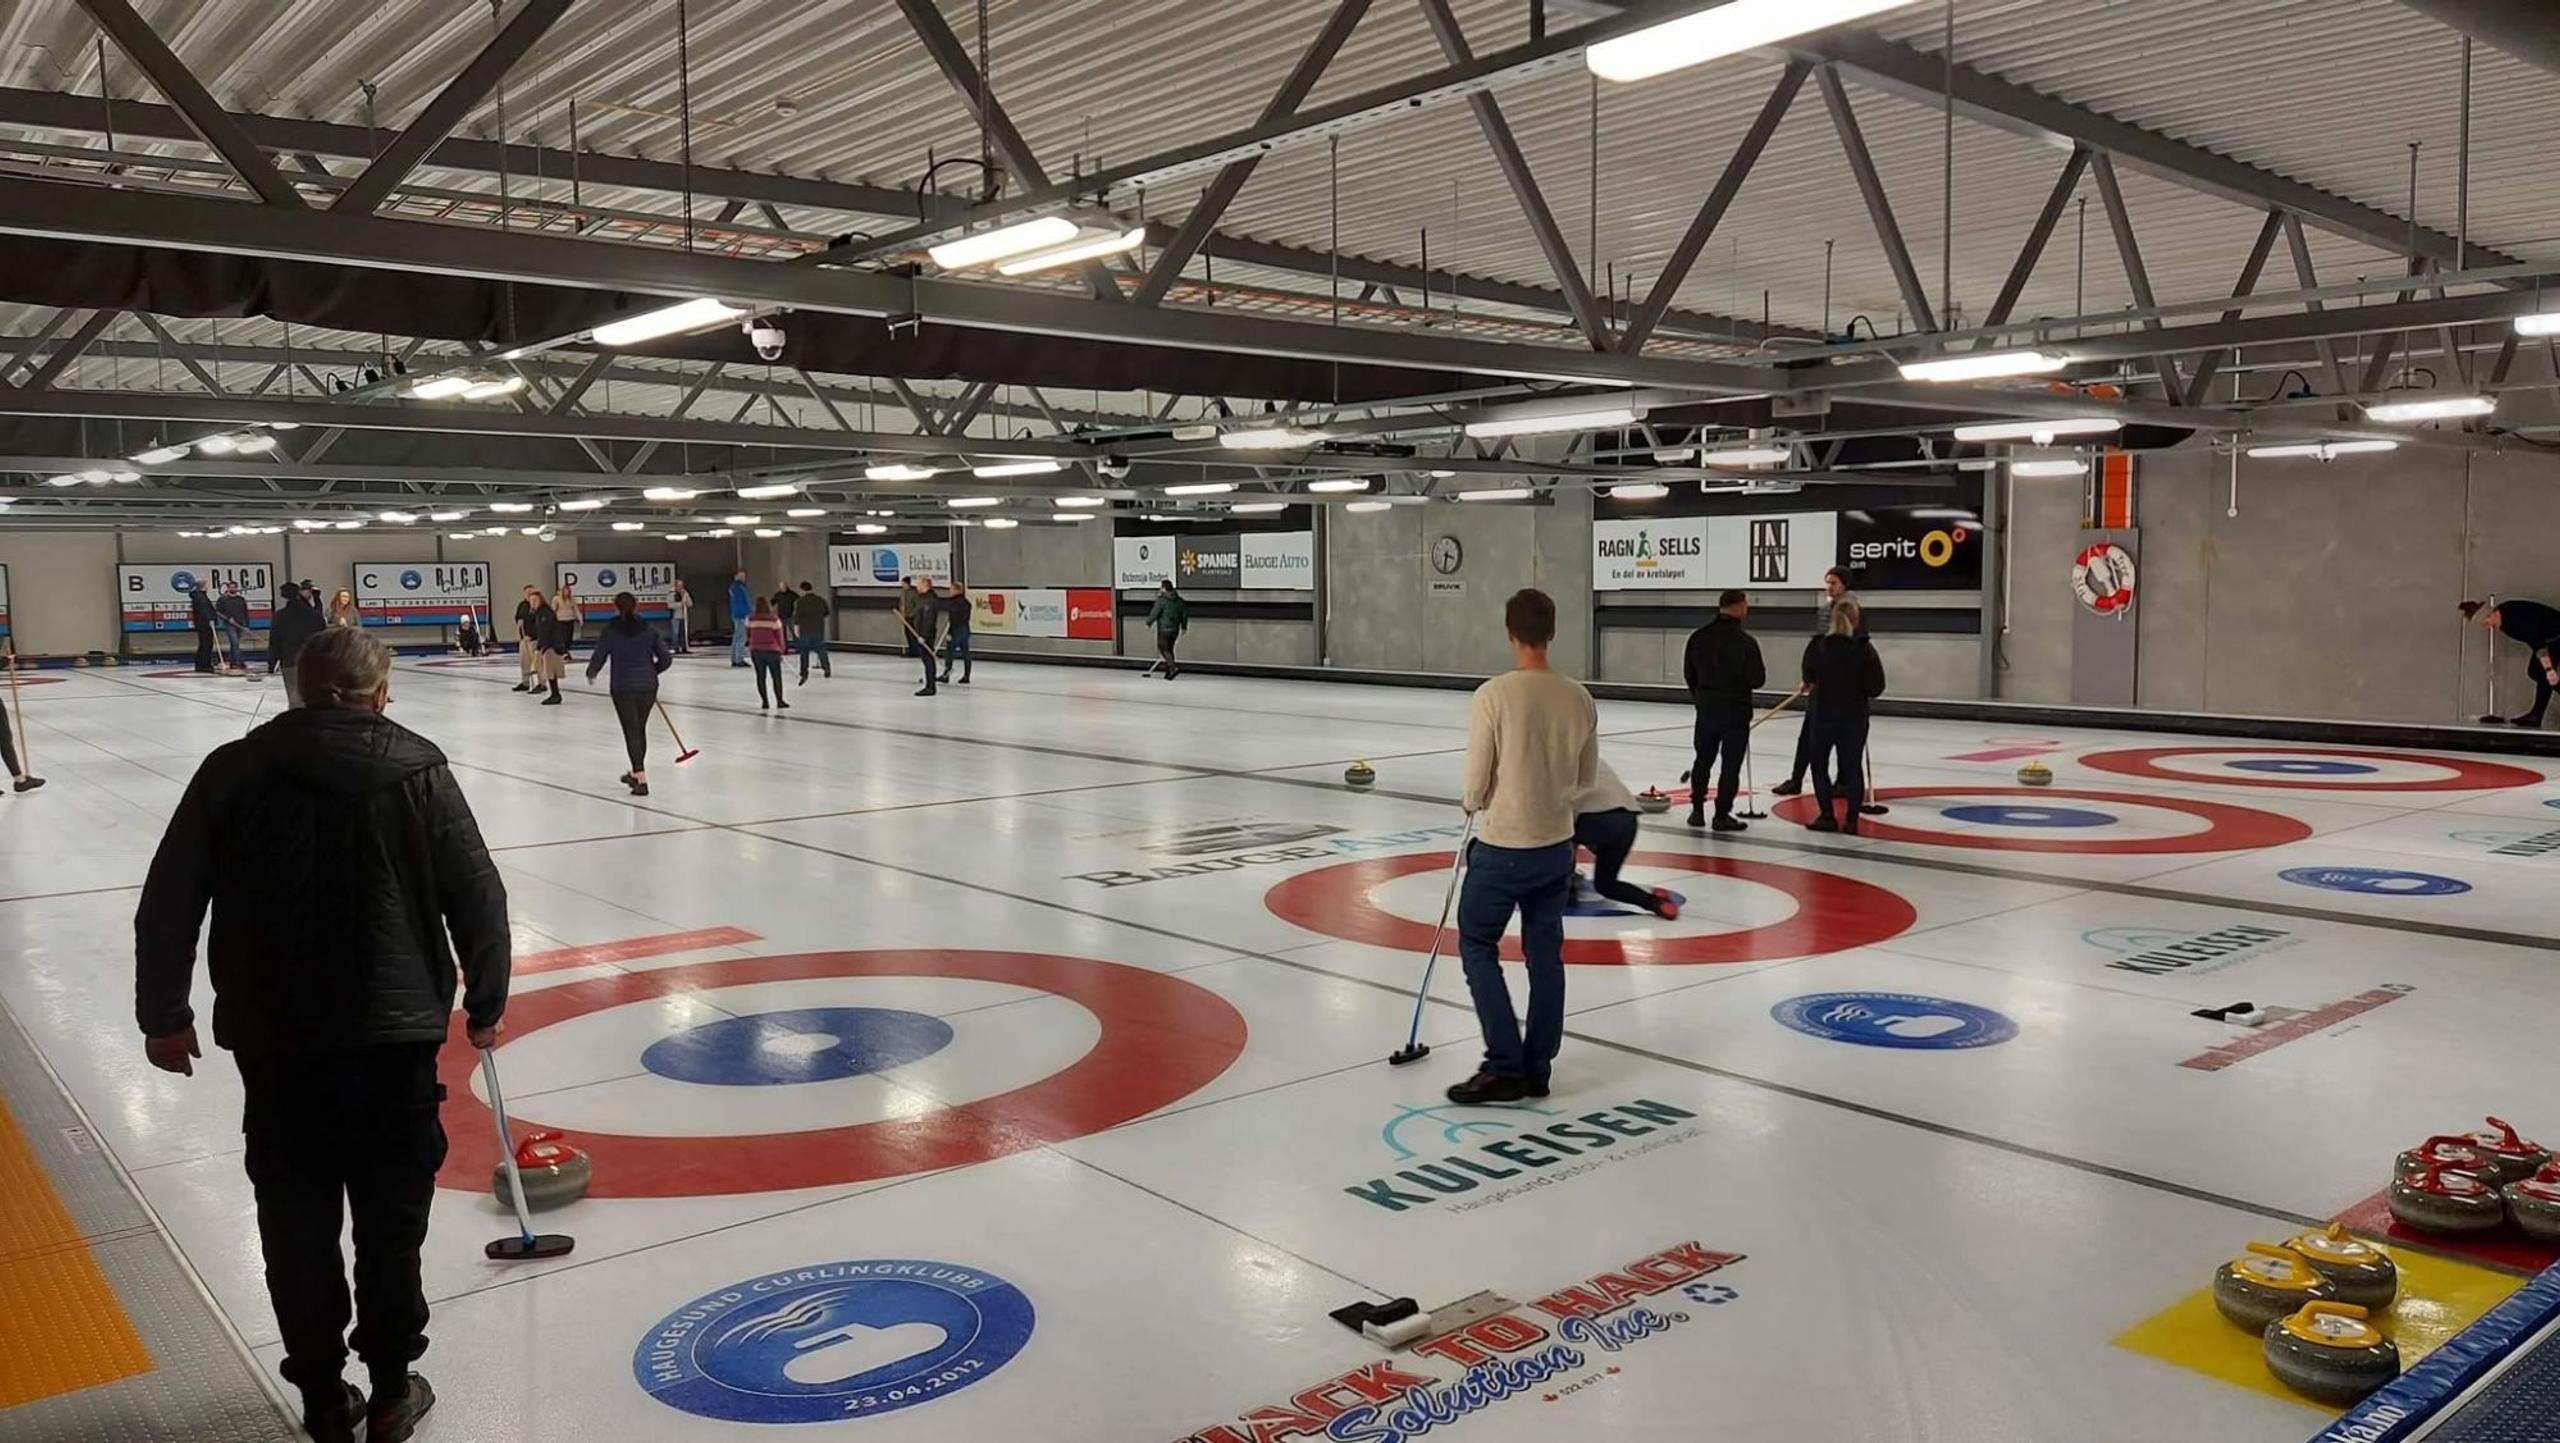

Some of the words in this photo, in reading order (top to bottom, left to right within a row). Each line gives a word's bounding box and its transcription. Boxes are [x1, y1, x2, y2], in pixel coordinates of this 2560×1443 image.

[1599, 540, 1634, 558] RAGN
[1659, 537, 1701, 556] SELLS
[1849, 537, 1916, 559] serit
[838, 552, 860, 572] MM
[1197, 552, 1238, 569] SPANNE
[1245, 554, 1278, 569] BAUGE
[1279, 553, 1310, 569] AUTO
[128, 575, 145, 592] B
[211, 569, 266, 589] RICO
[362, 573, 378, 589] C
[435, 567, 483, 586] RICO
[564, 572, 578, 586] D
[628, 566, 671, 585] RICO
[1060, 847, 1338, 889] BAUGE
[1329, 825, 1478, 851] AUT
[1343, 1098, 1698, 1213] KULEISEN
[1413, 1312, 1551, 1371] TO
[1527, 1240, 1748, 1321] HACK
[650, 1290, 743, 1383] HAUGESUND
[1324, 1341, 1584, 1443] Solution
[1558, 1298, 1691, 1352] Inc.
[843, 1357, 985, 1412] 23.04.2012
